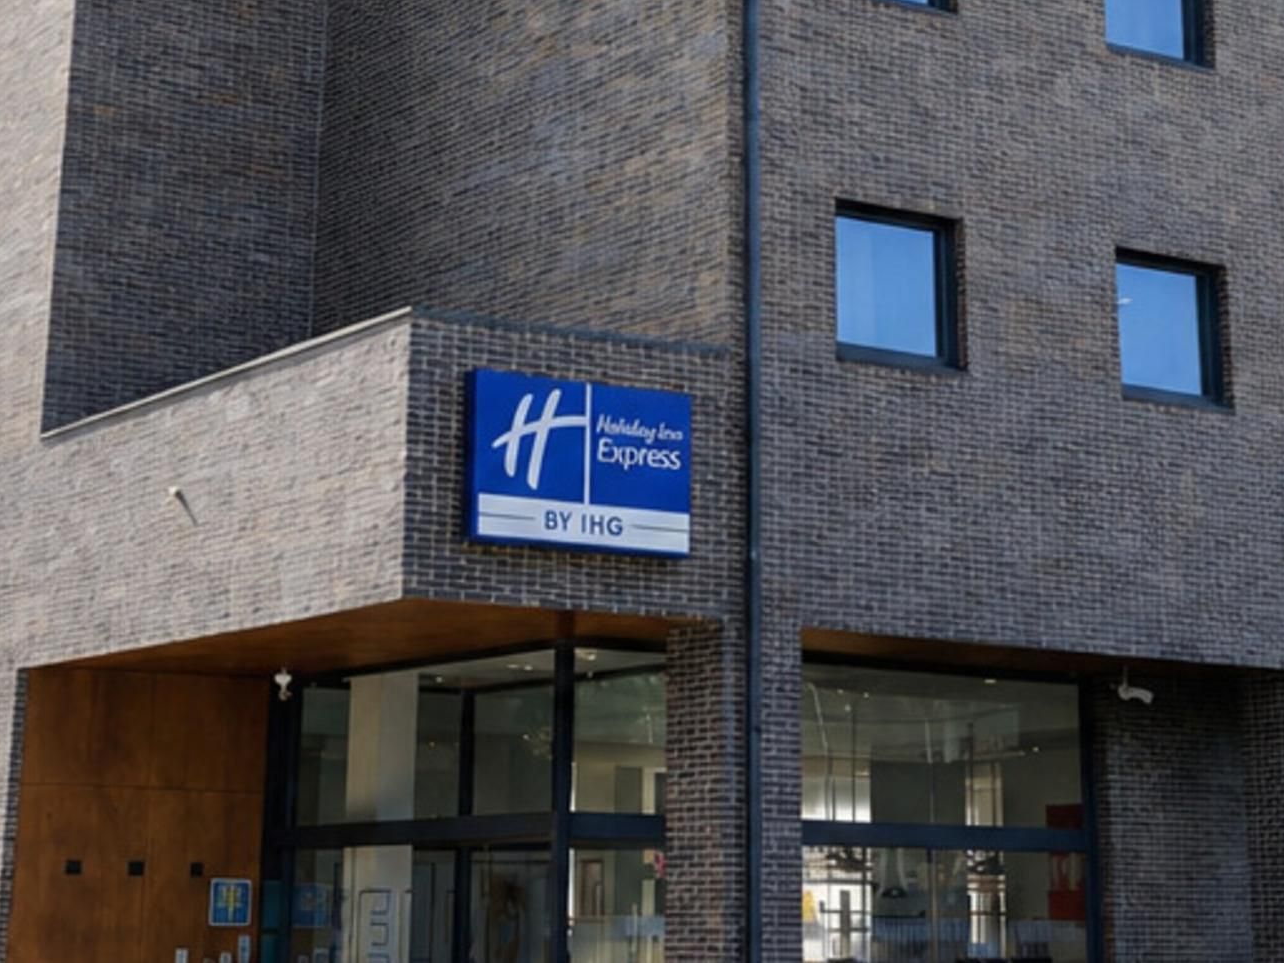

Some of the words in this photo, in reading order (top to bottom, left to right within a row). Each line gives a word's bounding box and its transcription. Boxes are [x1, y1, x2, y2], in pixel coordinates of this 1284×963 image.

[491, 389, 586, 490] H
[596, 414, 656, 444] Holiday
[657, 422, 683, 441] Inn
[598, 437, 681, 470] Express
[544, 509, 572, 531] BY
[581, 512, 623, 536] IHG
